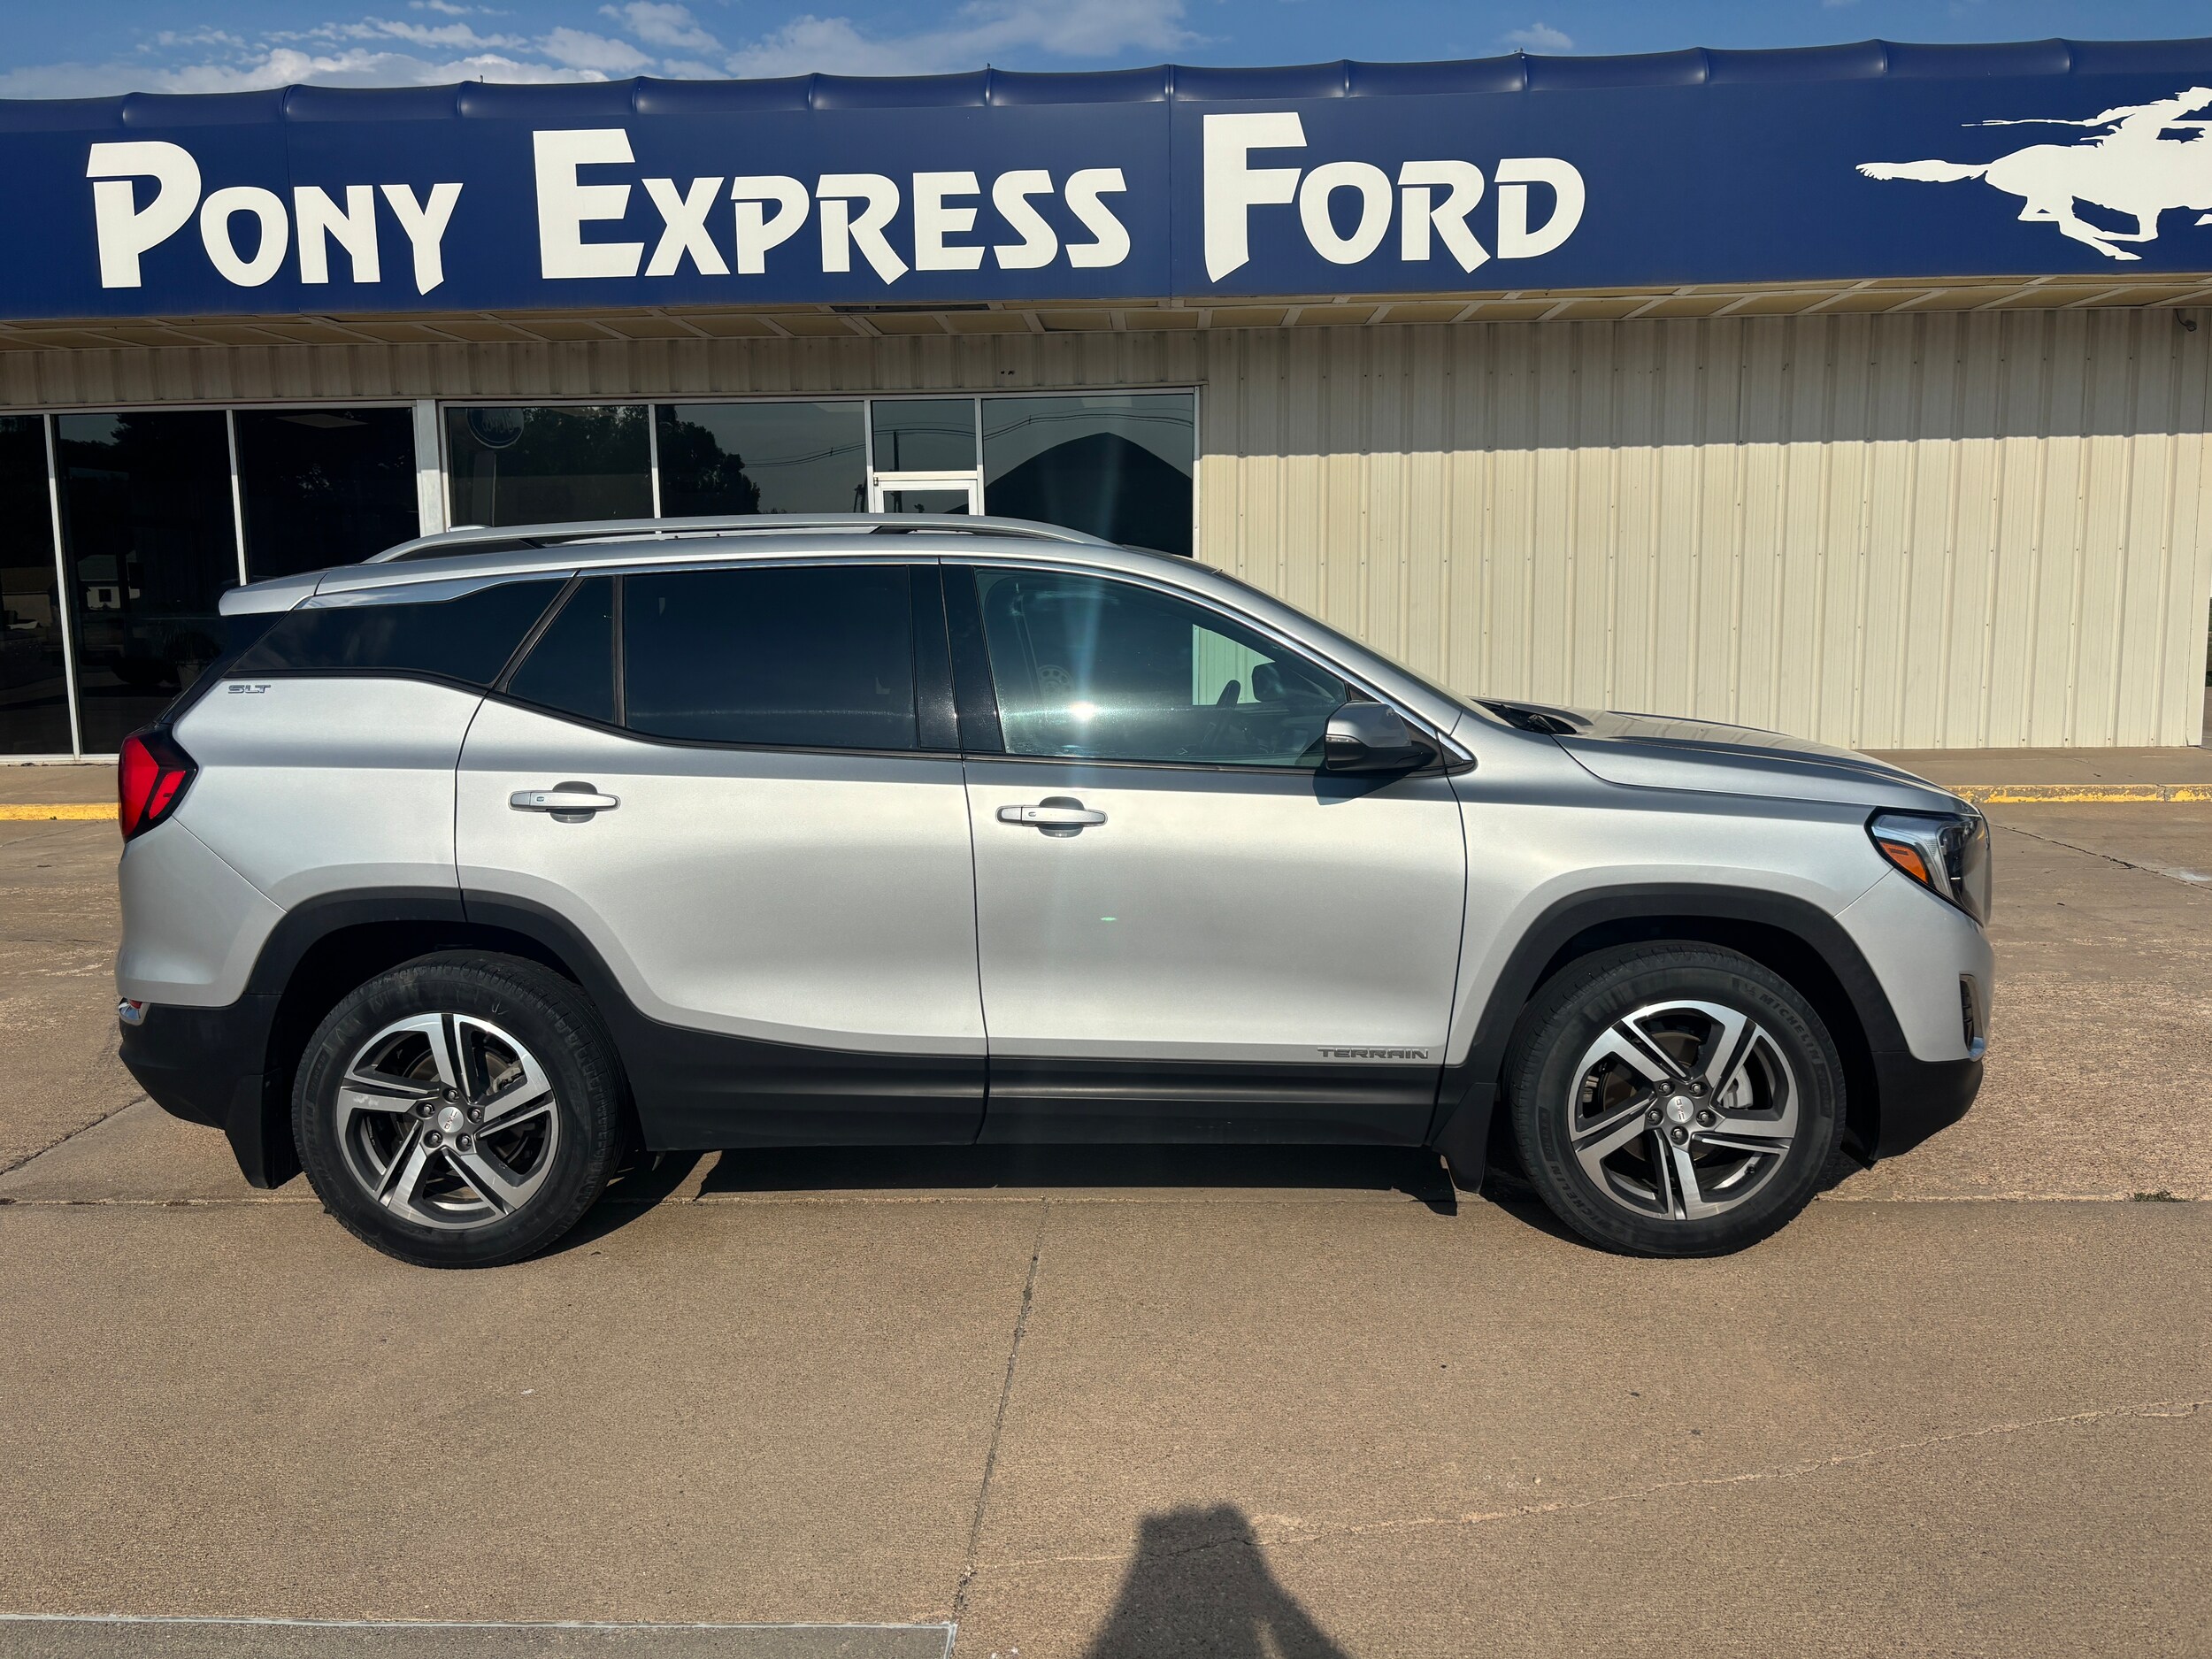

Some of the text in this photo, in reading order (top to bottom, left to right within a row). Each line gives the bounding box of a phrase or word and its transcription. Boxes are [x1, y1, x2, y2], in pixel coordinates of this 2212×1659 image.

[86, 111, 1586, 296] PONY EXPRESS FORD
[227, 684, 272, 695] SLT
[1758, 993, 1821, 1061] MICHELIN
[1317, 1047, 1429, 1060] TERRAIN
[1676, 1098, 1685, 1120] GMC
[444, 1110, 457, 1129] GMC
